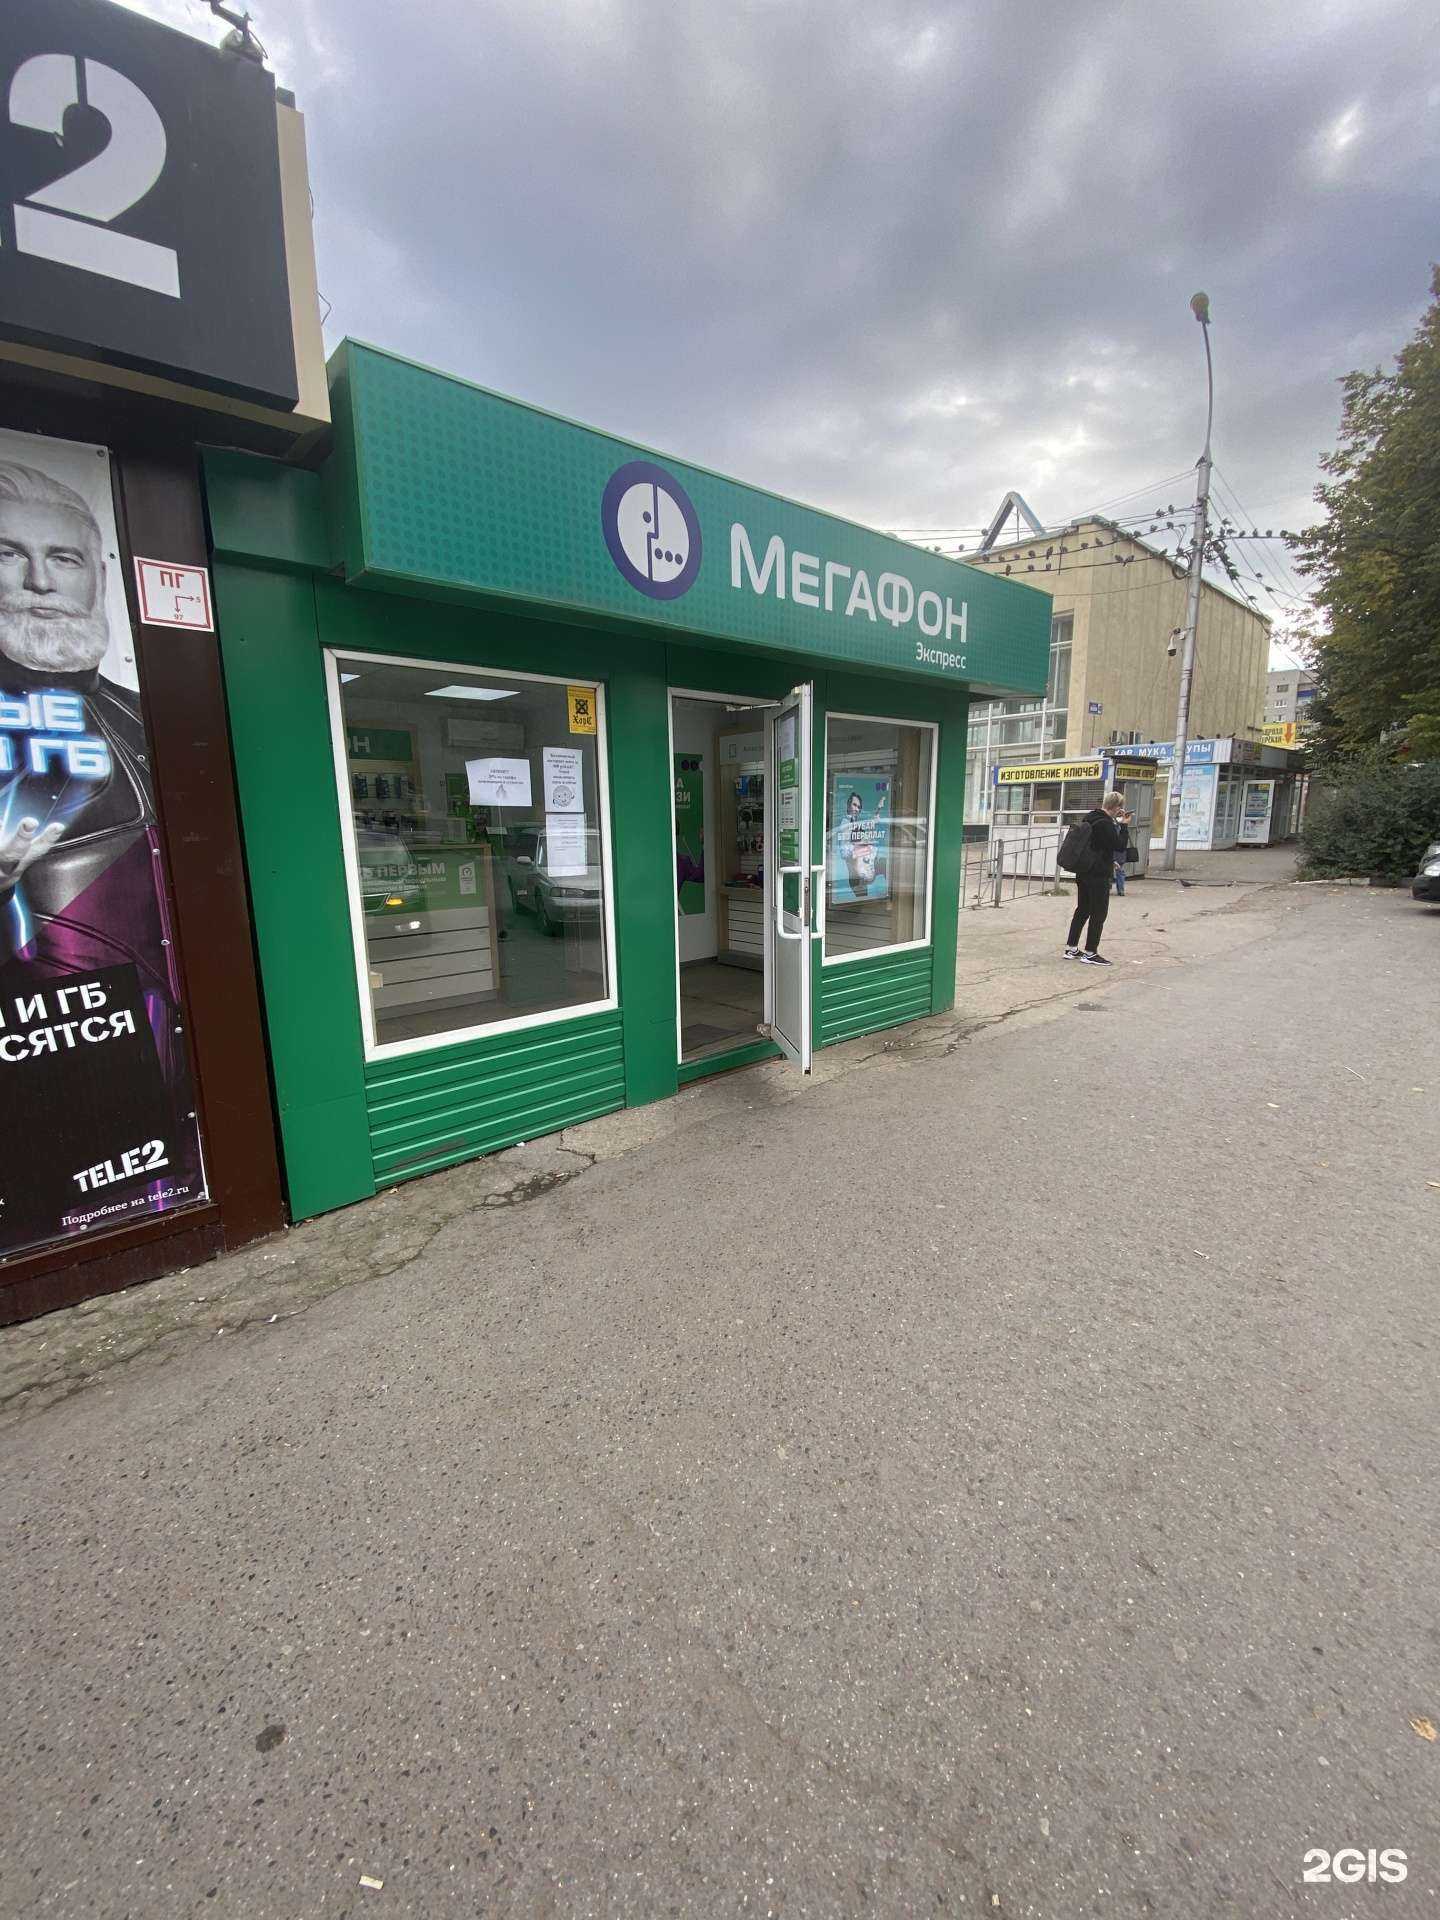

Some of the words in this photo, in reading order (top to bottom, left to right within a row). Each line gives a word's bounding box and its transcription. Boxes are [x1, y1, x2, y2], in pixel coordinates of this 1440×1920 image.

[160, 570, 184, 588] ПГ
[915, 642, 967, 670] Экспресс
[30, 738, 110, 777] ГБ
[1138, 746, 1167, 757] МУКА
[1001, 768, 1061, 781] ИЗГОТОВЛЕНИЕ
[1064, 764, 1100, 778] КЛЮЧЕЙ
[56, 982, 107, 1015] ГБ
[73, 1139, 169, 1193] TELE2
[62, 1201, 128, 1226] Подробнее
[131, 1197, 146, 1208] на
[148, 1185, 190, 1202] tele2.ru
